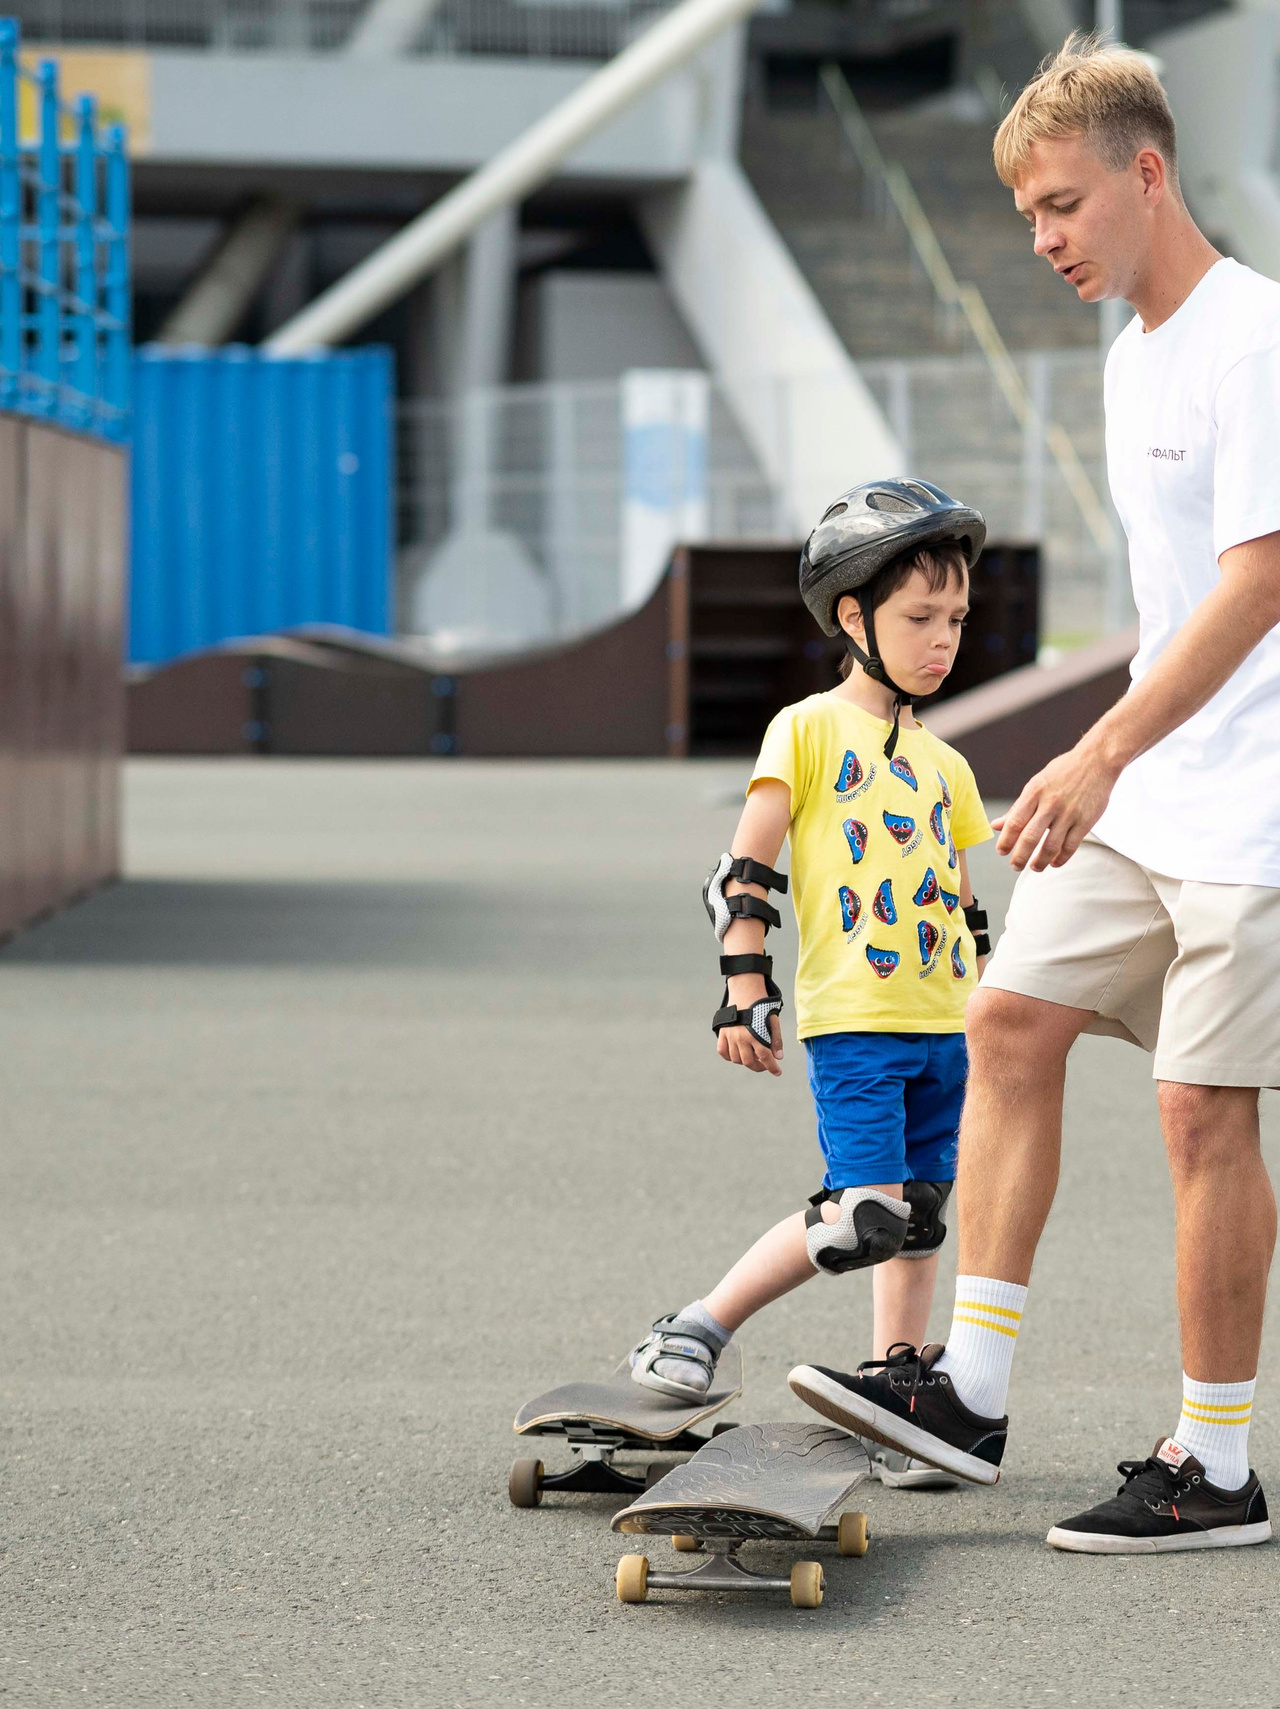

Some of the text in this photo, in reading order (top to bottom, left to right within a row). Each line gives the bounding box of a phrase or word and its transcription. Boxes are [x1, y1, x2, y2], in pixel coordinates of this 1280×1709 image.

[836, 762, 877, 803] HUGGY WUGGY
[902, 829, 923, 858] HUGGY
